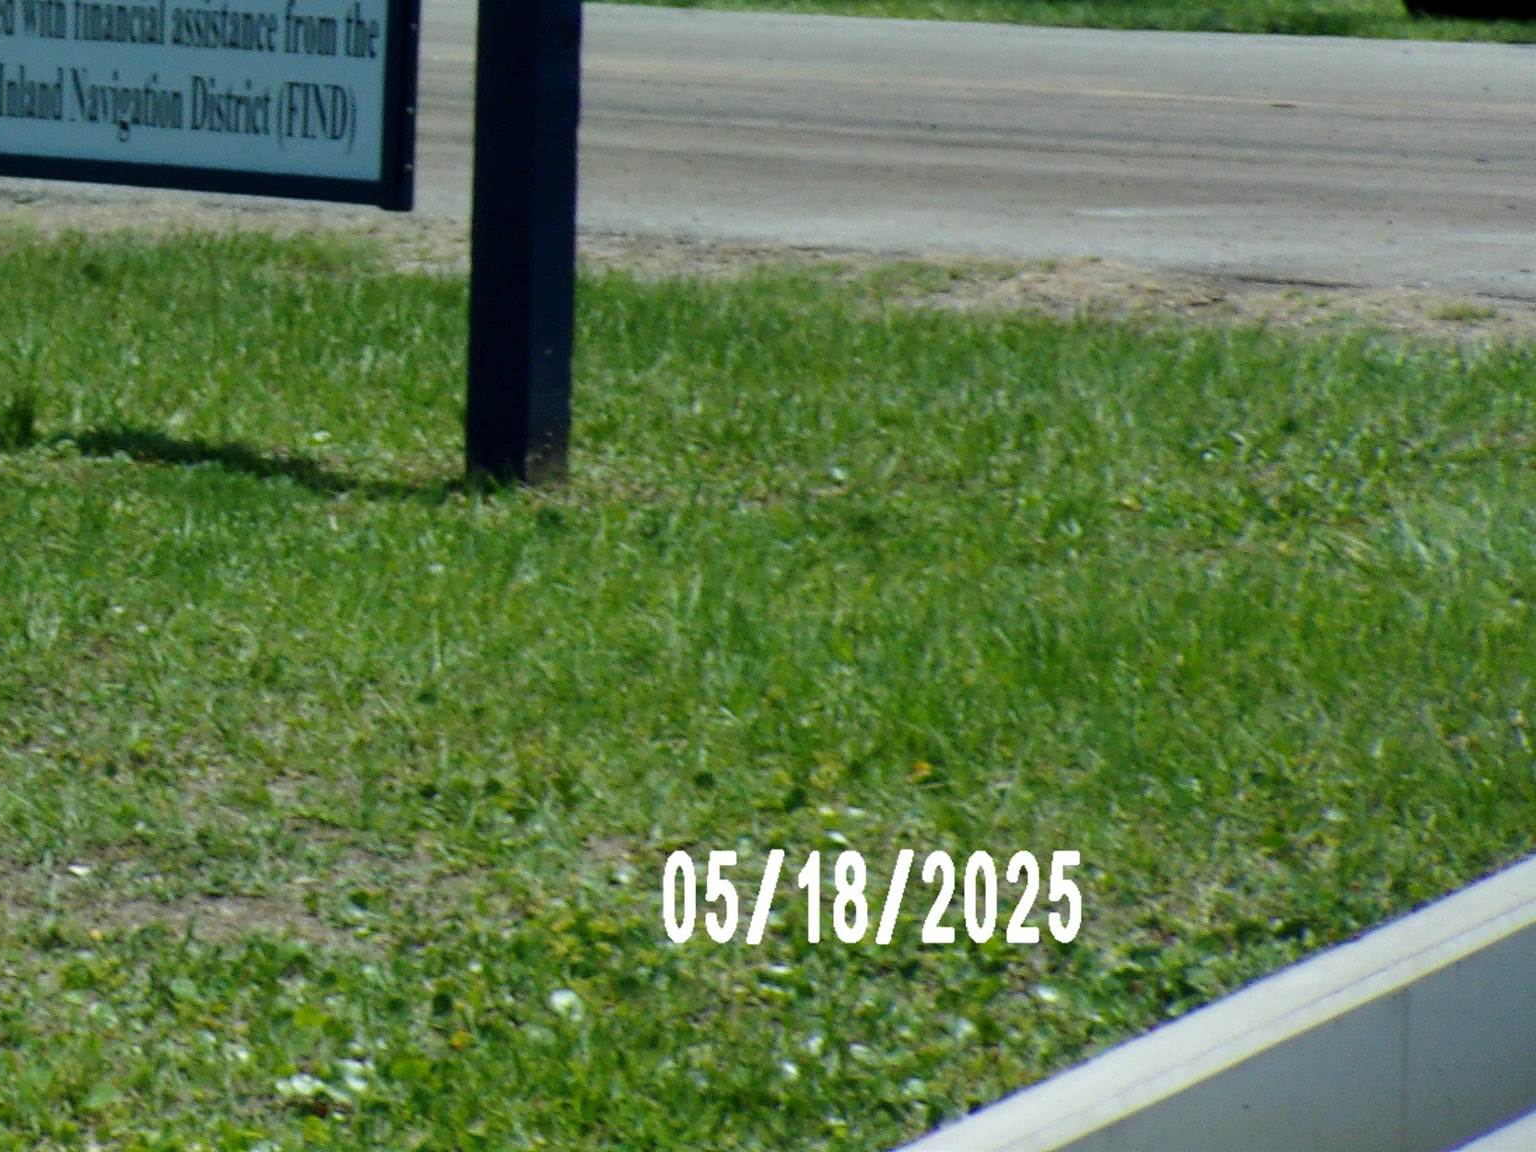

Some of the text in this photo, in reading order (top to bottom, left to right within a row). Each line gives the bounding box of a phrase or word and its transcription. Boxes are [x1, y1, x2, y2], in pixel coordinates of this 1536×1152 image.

[343, 0, 380, 59] the
[68, 66, 183, 144] Navigation
[189, 74, 272, 137] District
[276, 79, 358, 155] (FIND)
